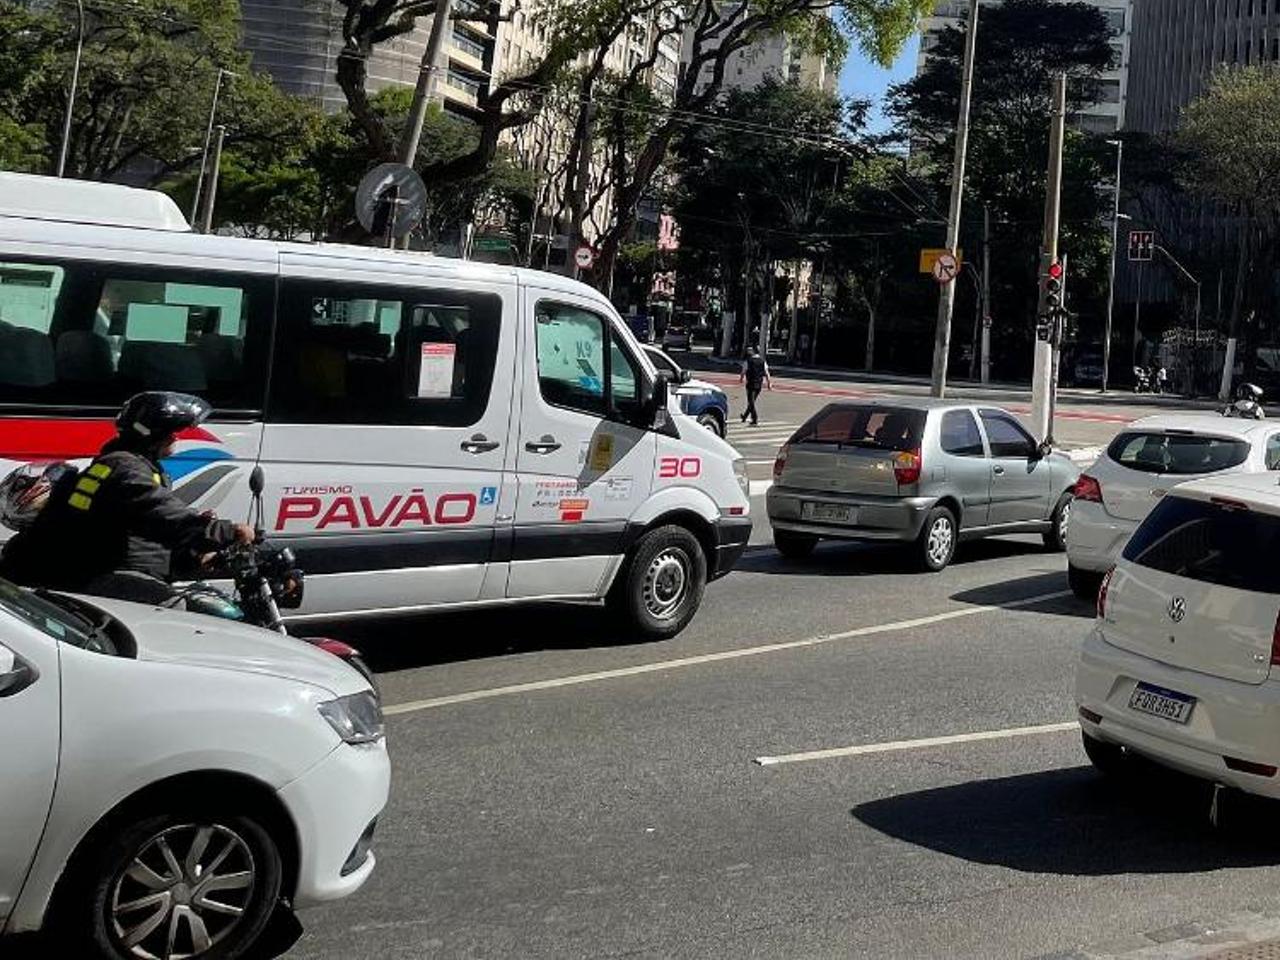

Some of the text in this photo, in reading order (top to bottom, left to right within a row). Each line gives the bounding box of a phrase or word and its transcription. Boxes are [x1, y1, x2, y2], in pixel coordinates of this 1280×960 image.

[659, 457, 701, 478] 30
[282, 486, 353, 495] TURISMO
[275, 488, 477, 531] PAVÃO
